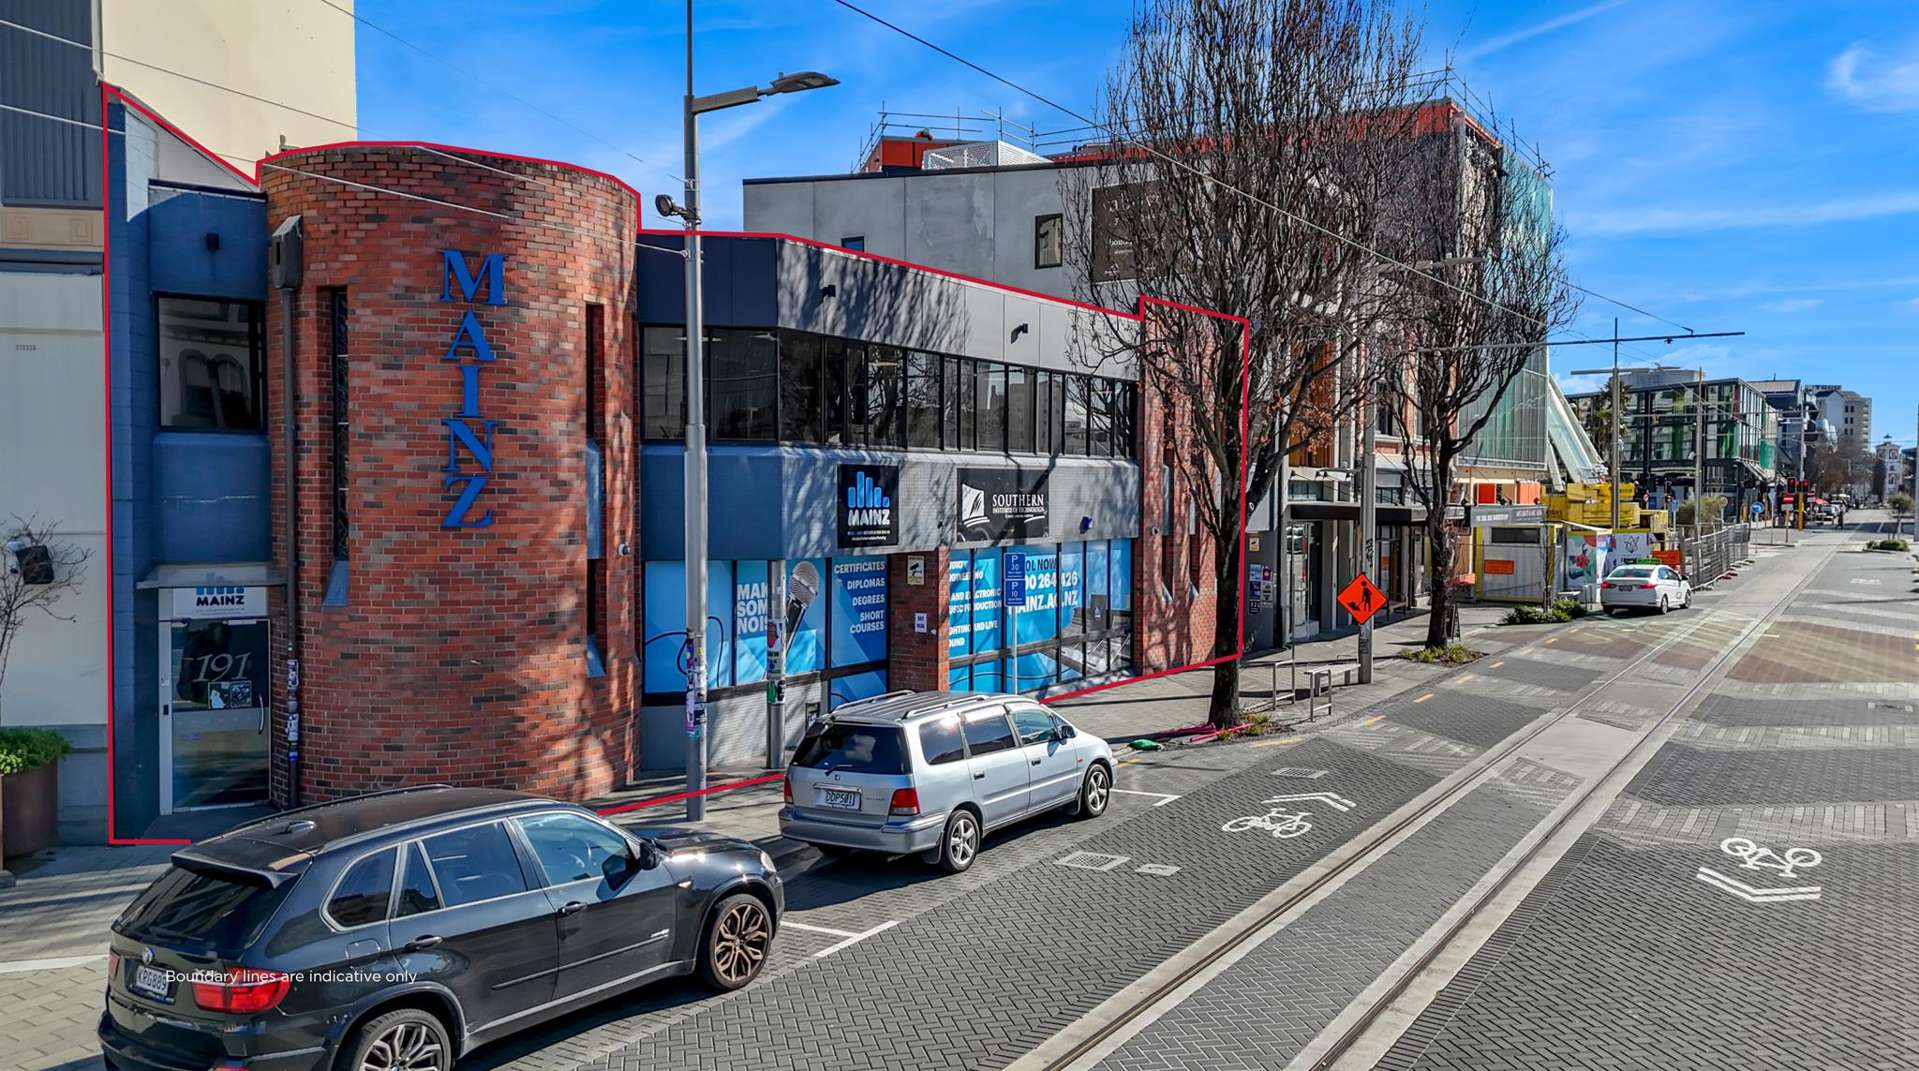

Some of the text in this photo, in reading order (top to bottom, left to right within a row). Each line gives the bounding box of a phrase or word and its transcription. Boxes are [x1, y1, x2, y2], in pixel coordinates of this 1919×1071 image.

[440, 249, 506, 529] MAINZ
[992, 493, 1045, 508] SOUTHERN
[847, 508, 891, 527] MAINZ
[1011, 554, 1019, 563] P
[834, 561, 885, 574] CERTIFICATES
[1025, 560, 1036, 572] OL
[847, 577, 885, 590] DIPLOMAS
[1011, 581, 1019, 590] P
[196, 595, 245, 607] MAINZ
[852, 594, 885, 606] DEGREES
[737, 598, 768, 618] SOM
[860, 610, 884, 622] SHORT
[850, 621, 884, 634] COURSES
[191, 652, 252, 682] 191
